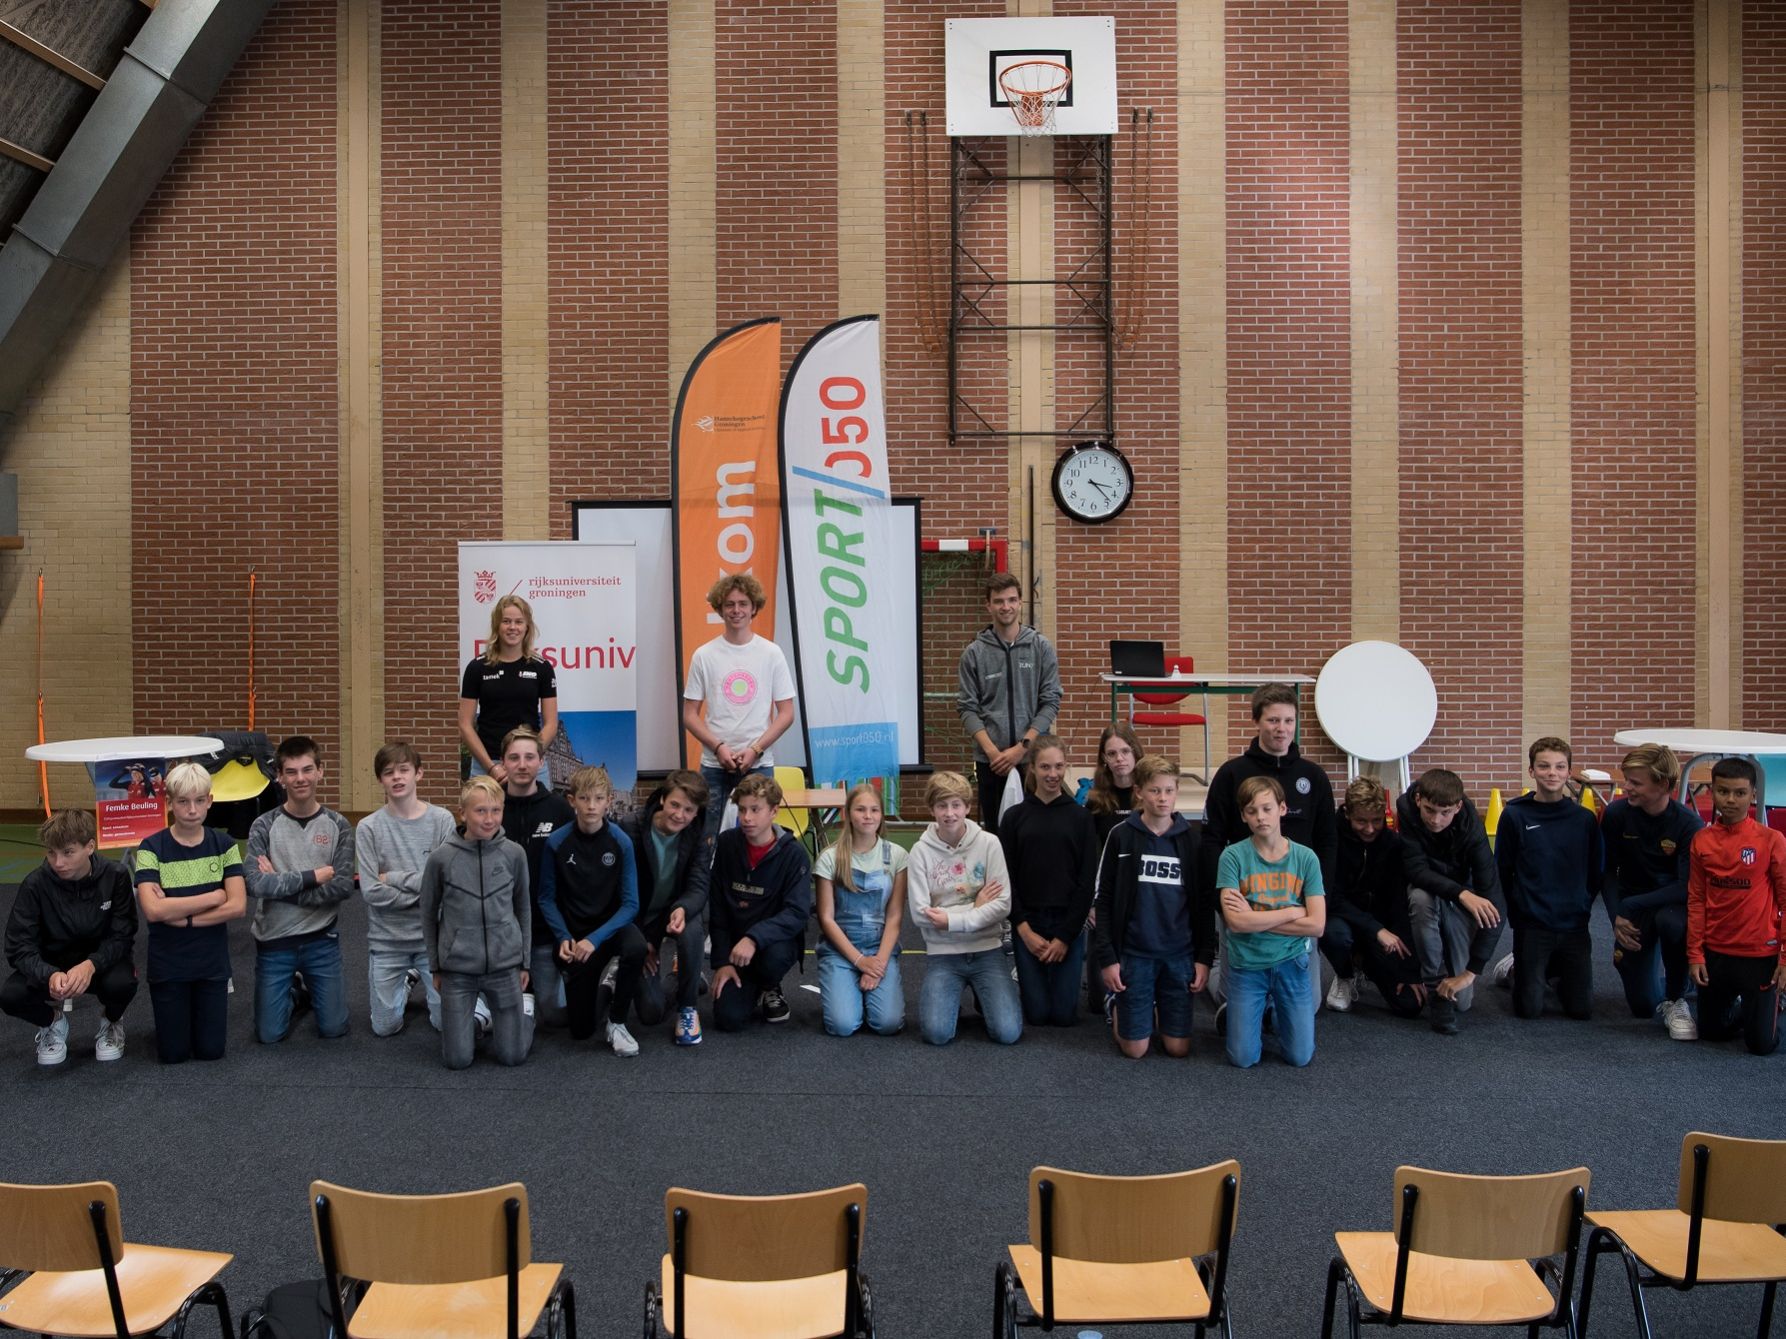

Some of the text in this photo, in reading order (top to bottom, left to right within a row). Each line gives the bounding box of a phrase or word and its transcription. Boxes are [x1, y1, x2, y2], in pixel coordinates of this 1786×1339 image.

[1079, 460, 1087, 468] 11
[1089, 456, 1099, 464] 12
[1070, 469, 1080, 477] 10
[1111, 466, 1116, 475] 2
[1066, 479, 1073, 487] 9
[1116, 478, 1121, 487] 3
[1070, 490, 1077, 499] 8
[1111, 490, 1117, 498] 4
[1080, 498, 1086, 507] 7
[1090, 502, 1097, 510] 6
[528, 576, 622, 588] rijksuniversiteit
[528, 588, 587, 599] groningen
[105, 802, 158, 811] Femke Beuling
